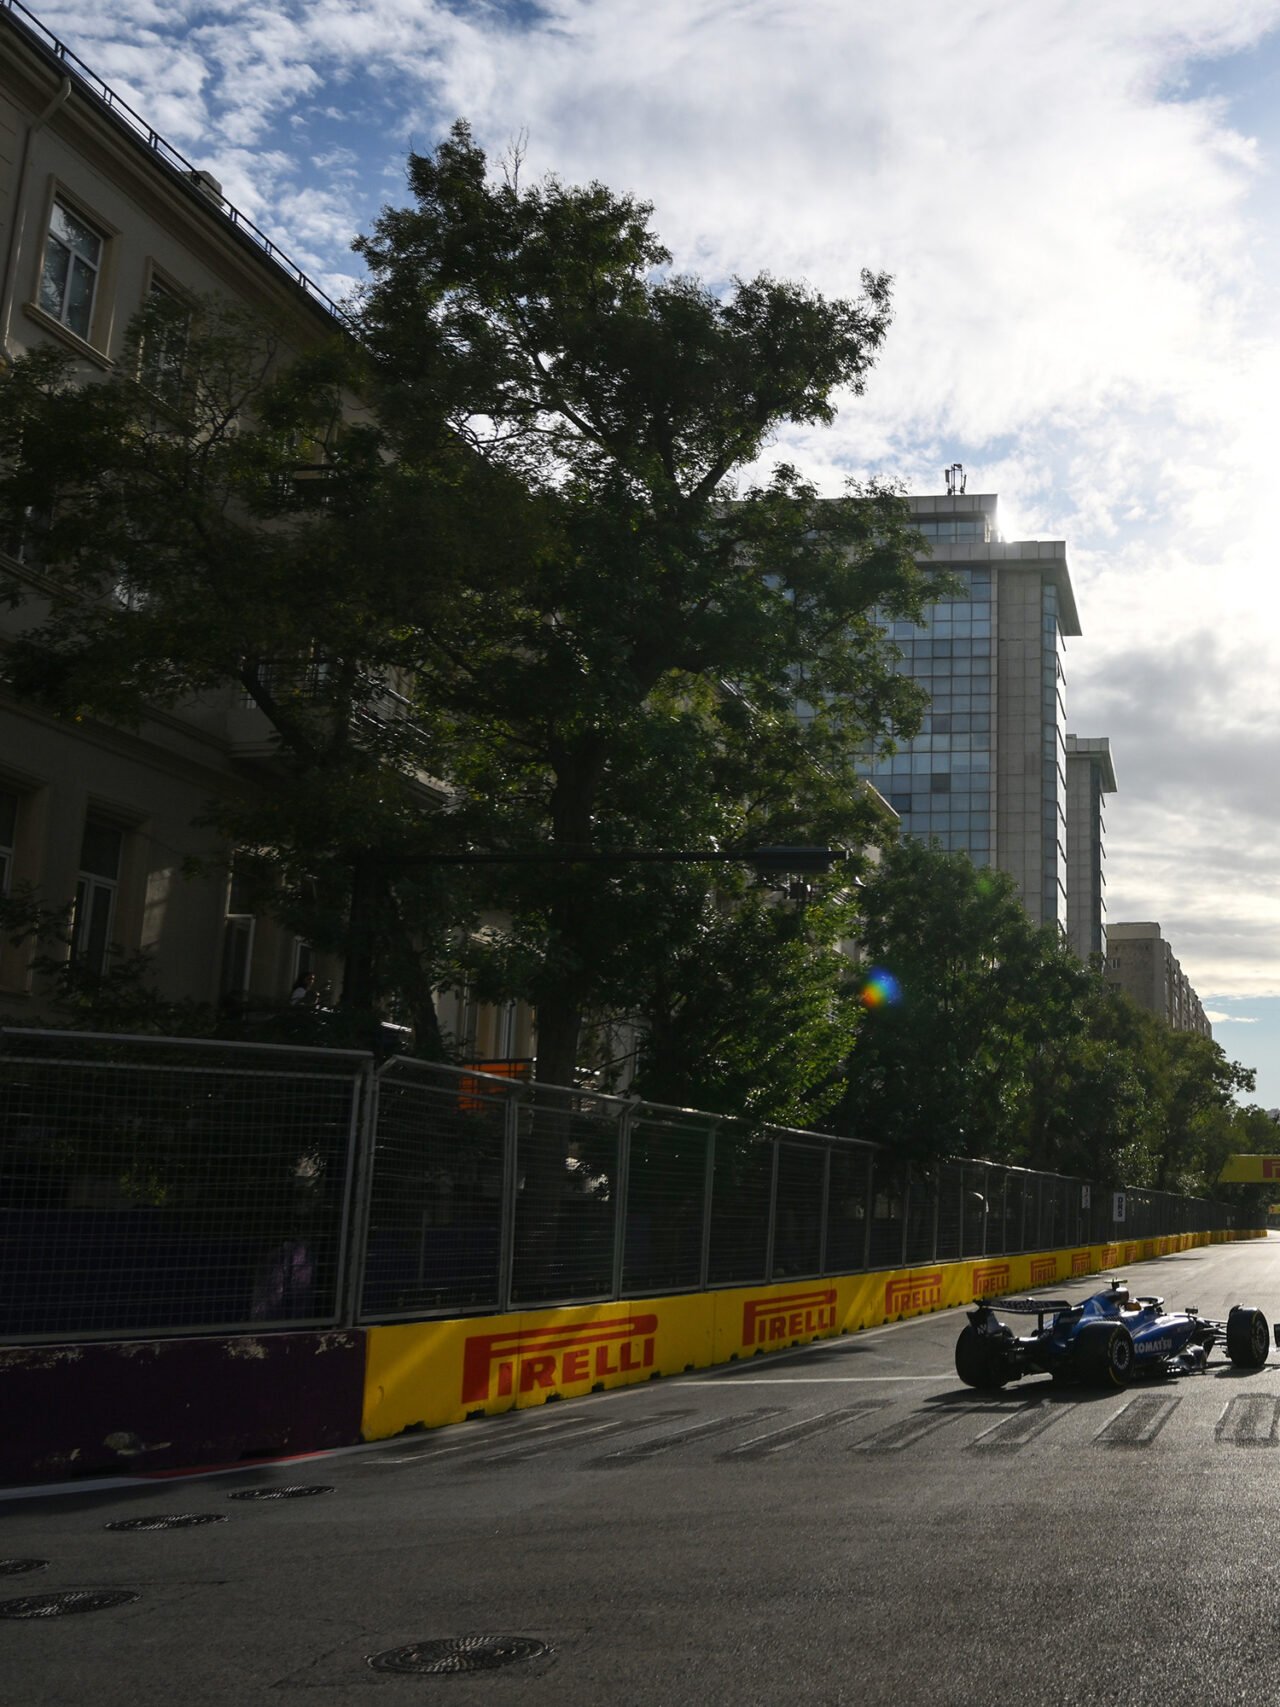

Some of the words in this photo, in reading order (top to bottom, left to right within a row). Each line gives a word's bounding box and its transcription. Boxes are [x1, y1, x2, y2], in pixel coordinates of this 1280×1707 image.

[885, 1274, 942, 1315] PIRELLI
[973, 1264, 1009, 1295] PIRELLI
[742, 1288, 837, 1346] PIRELLI
[461, 1314, 658, 1404] PIRELLI
